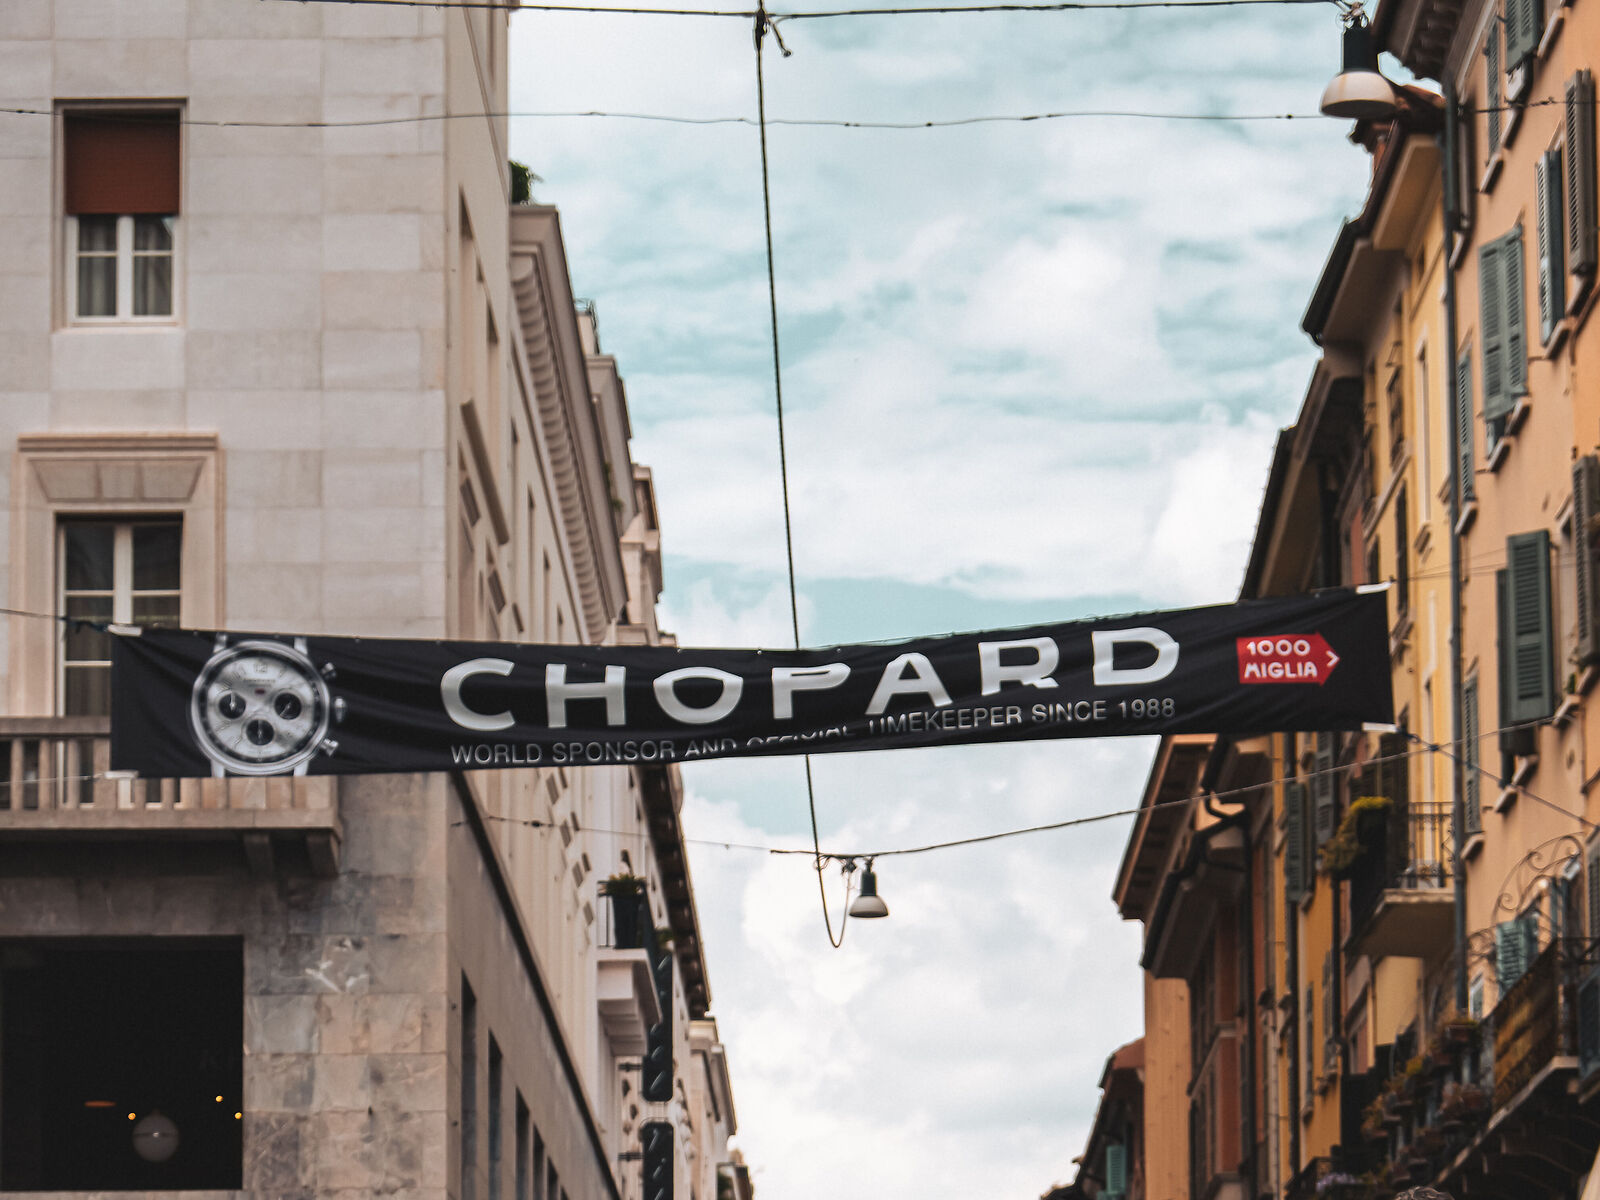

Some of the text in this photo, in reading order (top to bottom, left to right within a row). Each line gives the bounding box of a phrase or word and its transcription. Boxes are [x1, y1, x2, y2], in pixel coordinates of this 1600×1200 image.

[1246, 639, 1311, 656] 1000
[440, 626, 1180, 731] CHOPARD
[1244, 661, 1318, 678] MIGLIA
[1031, 700, 1107, 723] SINCE
[1118, 697, 1175, 719] 1988
[451, 743, 543, 764] WORLD
[552, 740, 676, 763] SPONSOR
